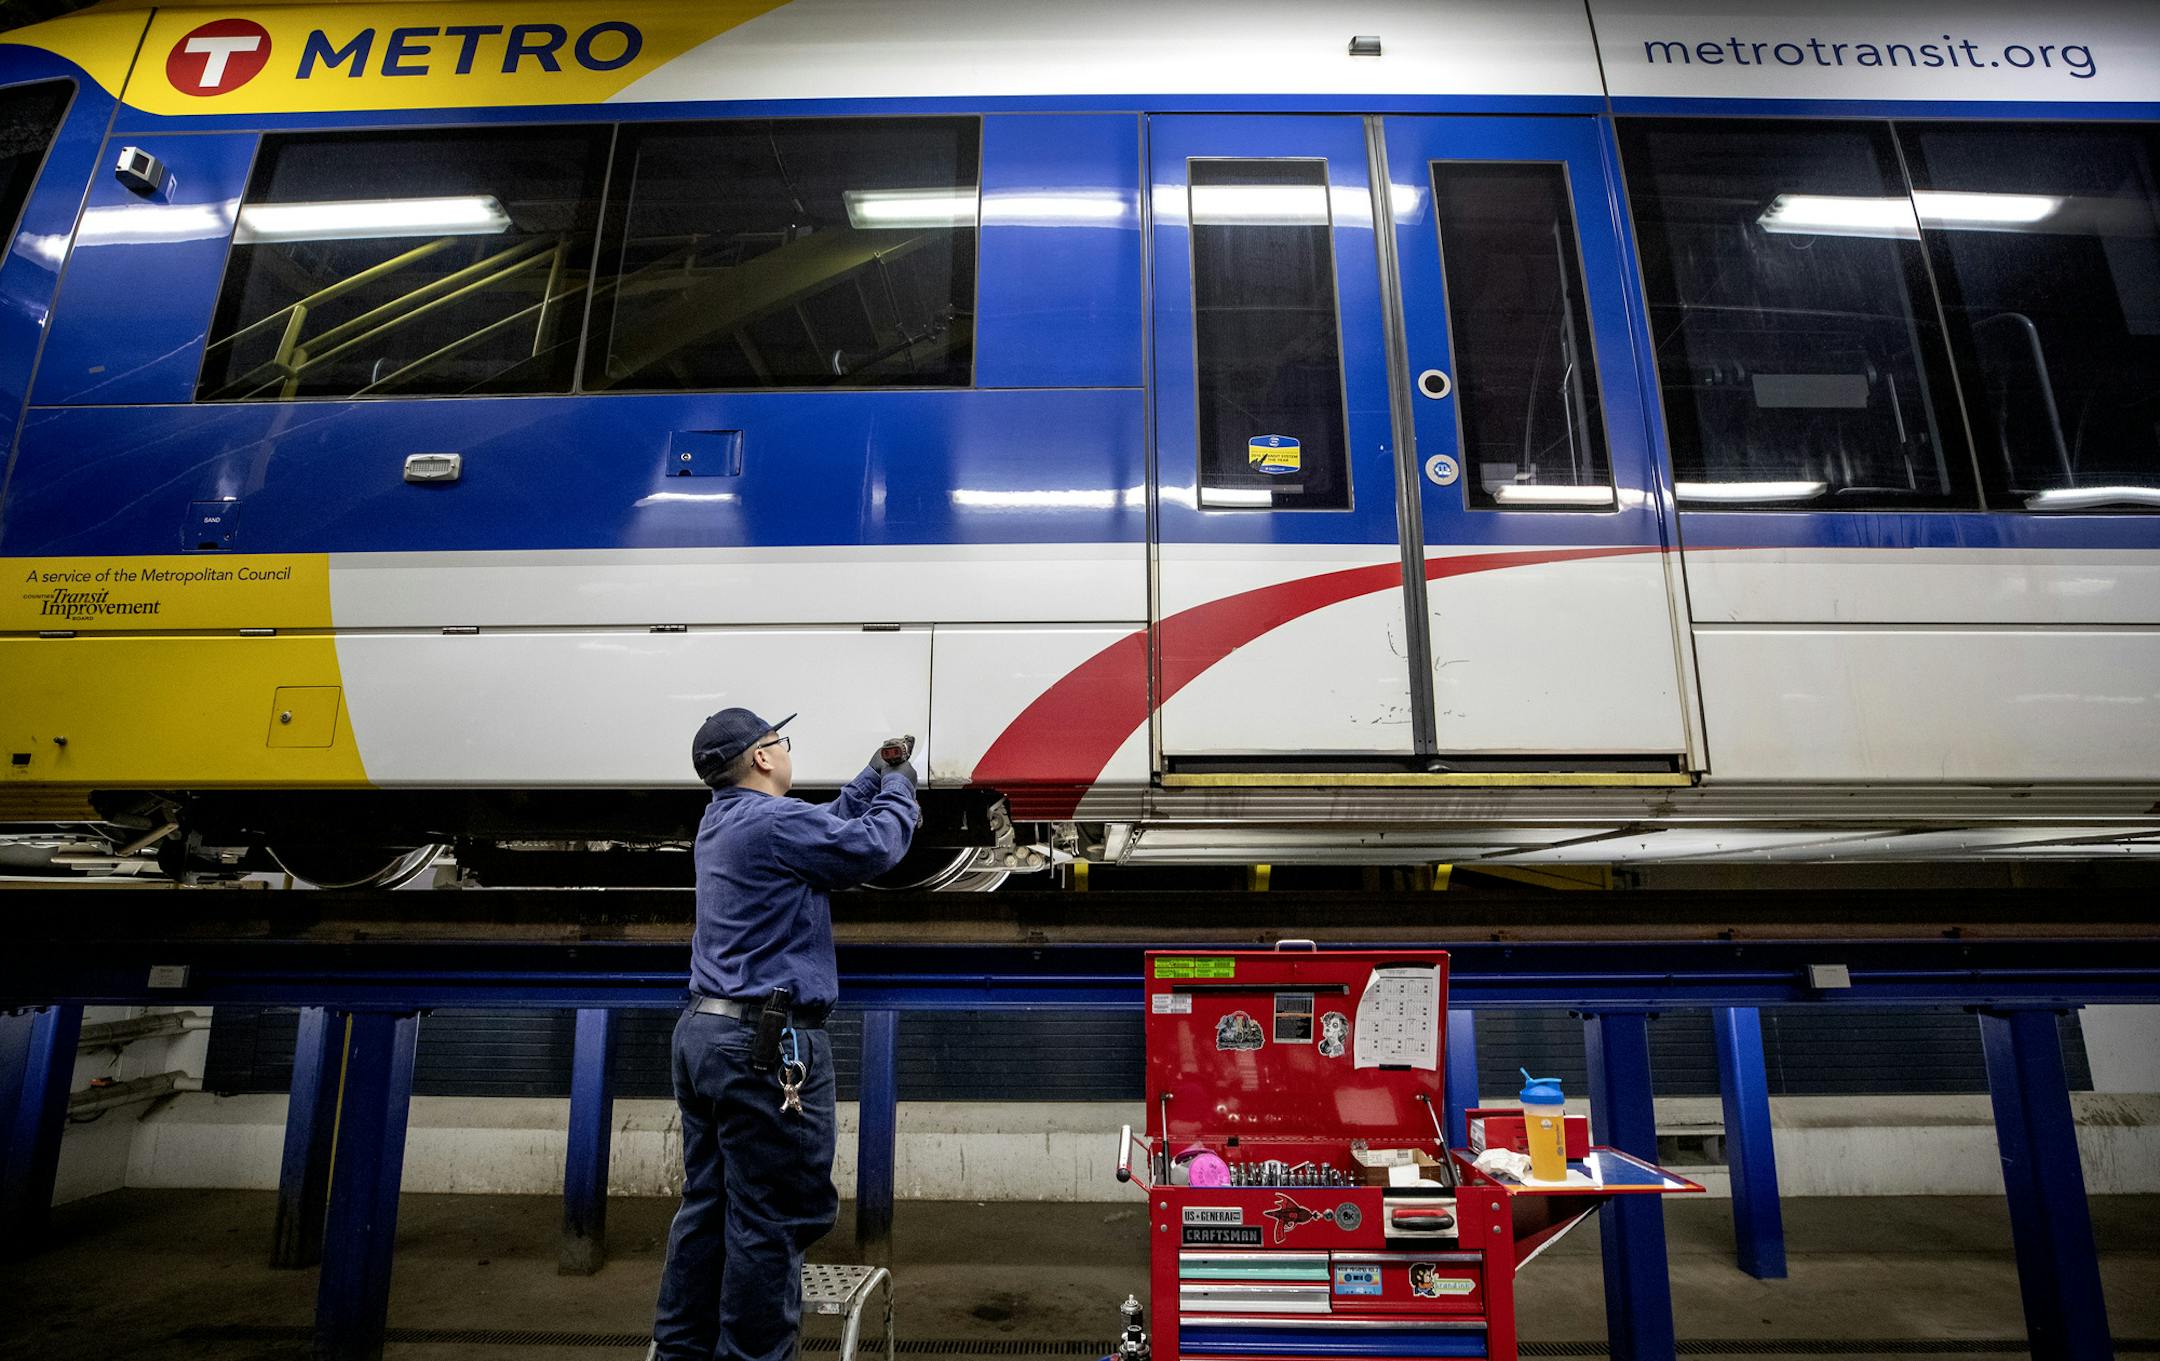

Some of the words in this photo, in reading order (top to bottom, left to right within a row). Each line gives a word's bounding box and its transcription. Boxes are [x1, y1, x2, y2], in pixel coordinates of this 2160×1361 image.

[296, 20, 644, 80] METRO
[1643, 34, 2098, 79] metrotransit.org
[26, 570, 38, 583] A
[42, 569, 91, 583] service
[95, 568, 112, 582] of
[114, 568, 137, 582] the
[141, 567, 234, 585] Metropolitan
[238, 566, 291, 581] Council
[53, 588, 109, 603] Transit
[40, 600, 160, 619] Improvement
[1184, 1210, 1195, 1222] US
[1200, 1211, 1233, 1222] GENERAL
[1186, 1229, 1257, 1241] CRAFTSMAN
